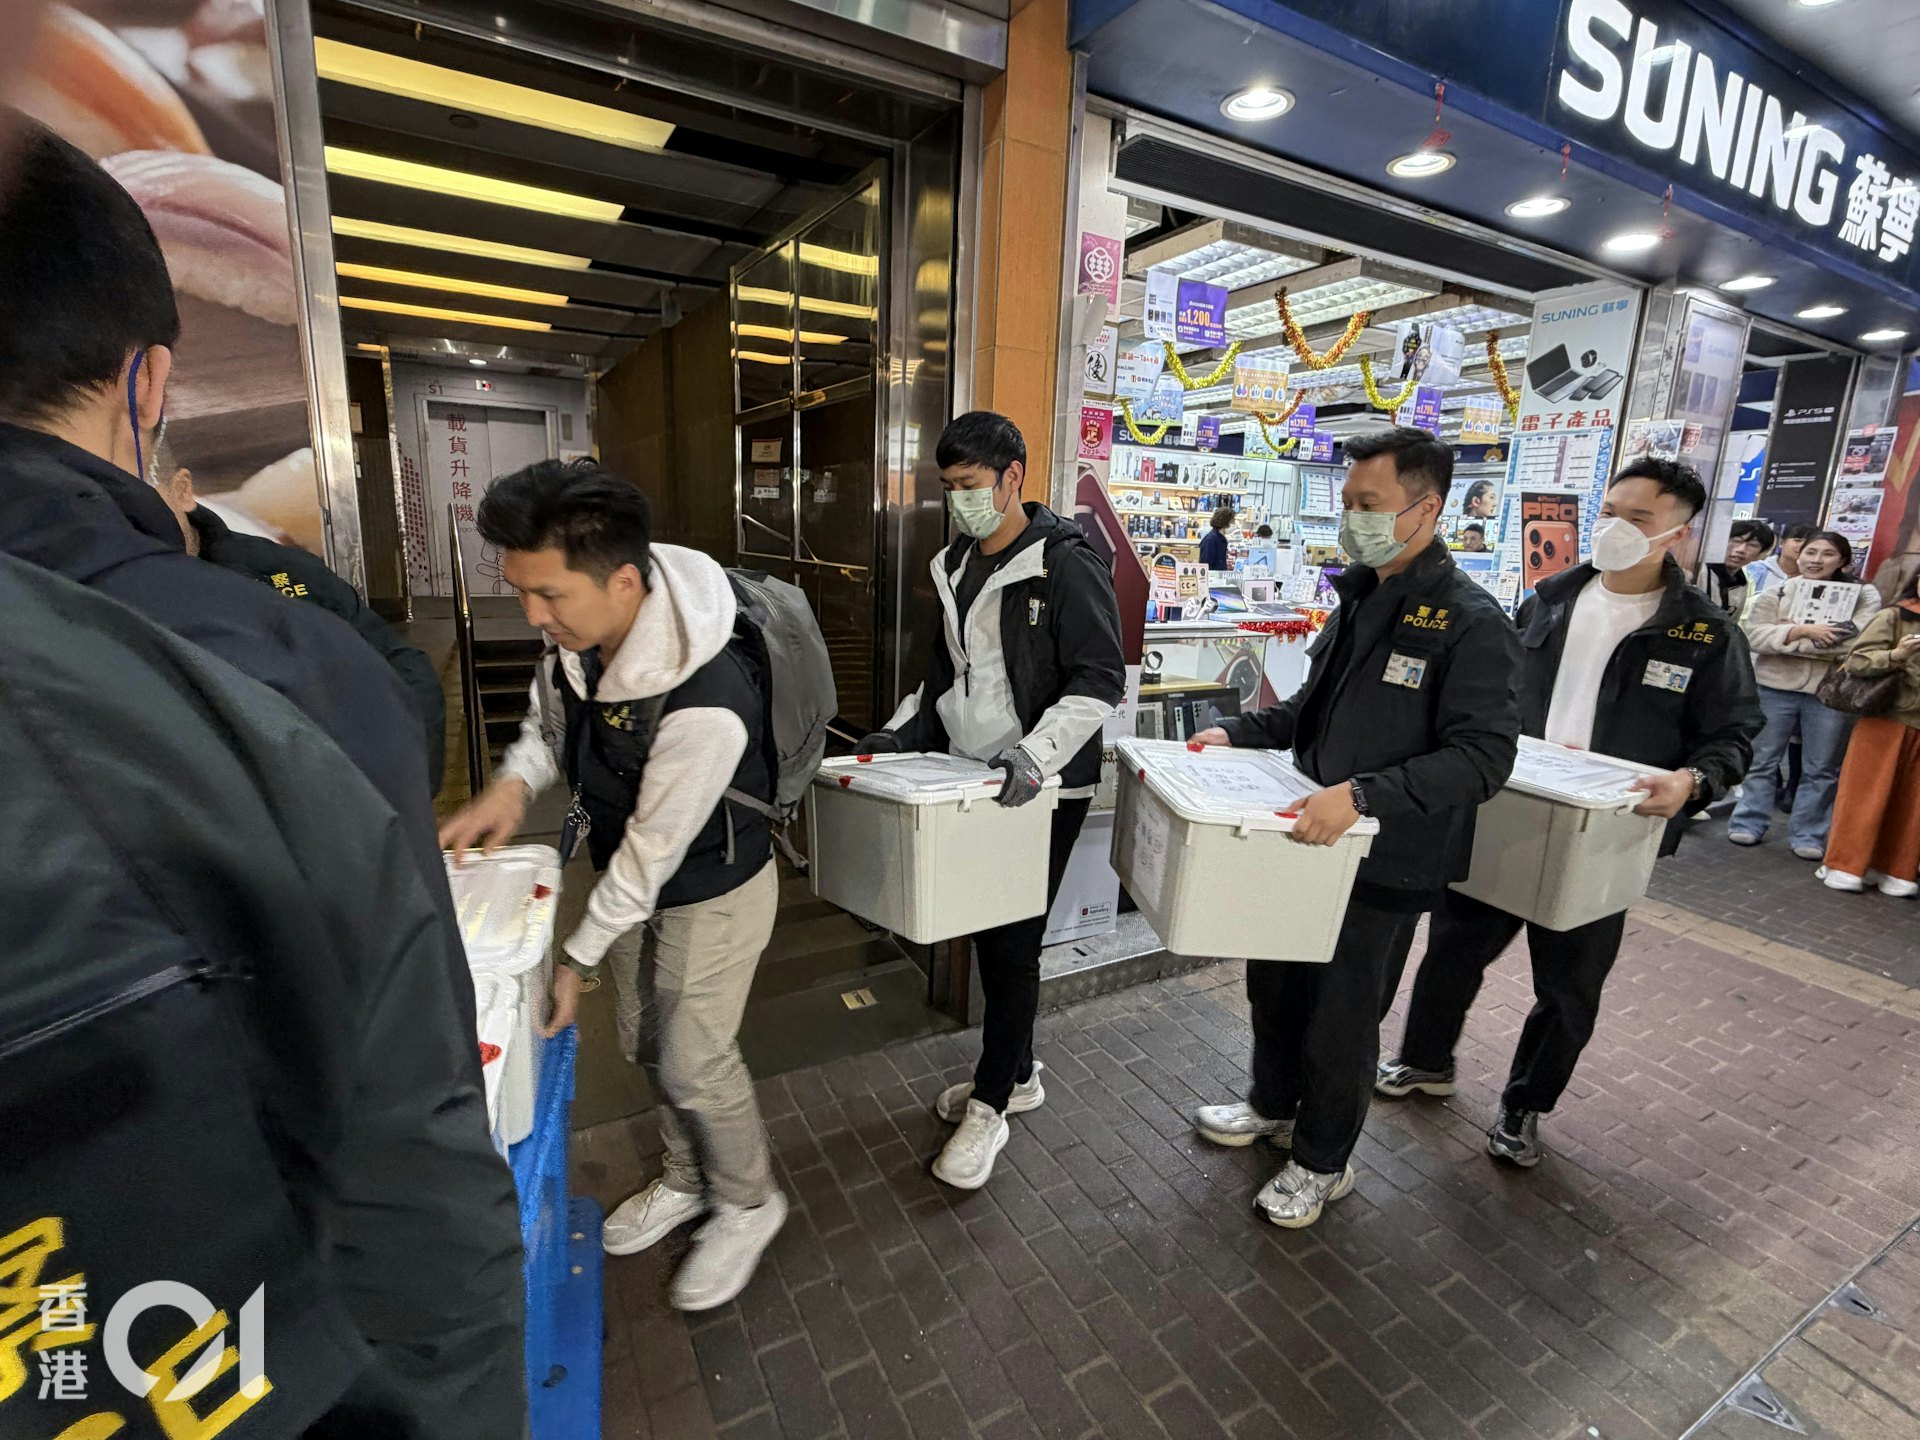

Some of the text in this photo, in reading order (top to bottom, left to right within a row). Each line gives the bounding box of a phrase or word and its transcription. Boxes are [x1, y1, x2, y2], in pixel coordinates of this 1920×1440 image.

[1559, 0, 1845, 226] SUNING
[1541, 305, 1599, 324] SUNING
[428, 384, 443, 395] S1
[1521, 408, 1611, 431] 電子產品
[1523, 502, 1577, 521] PRO
[1403, 614, 1449, 630] POLICE
[1667, 628, 1715, 644] OLICE
